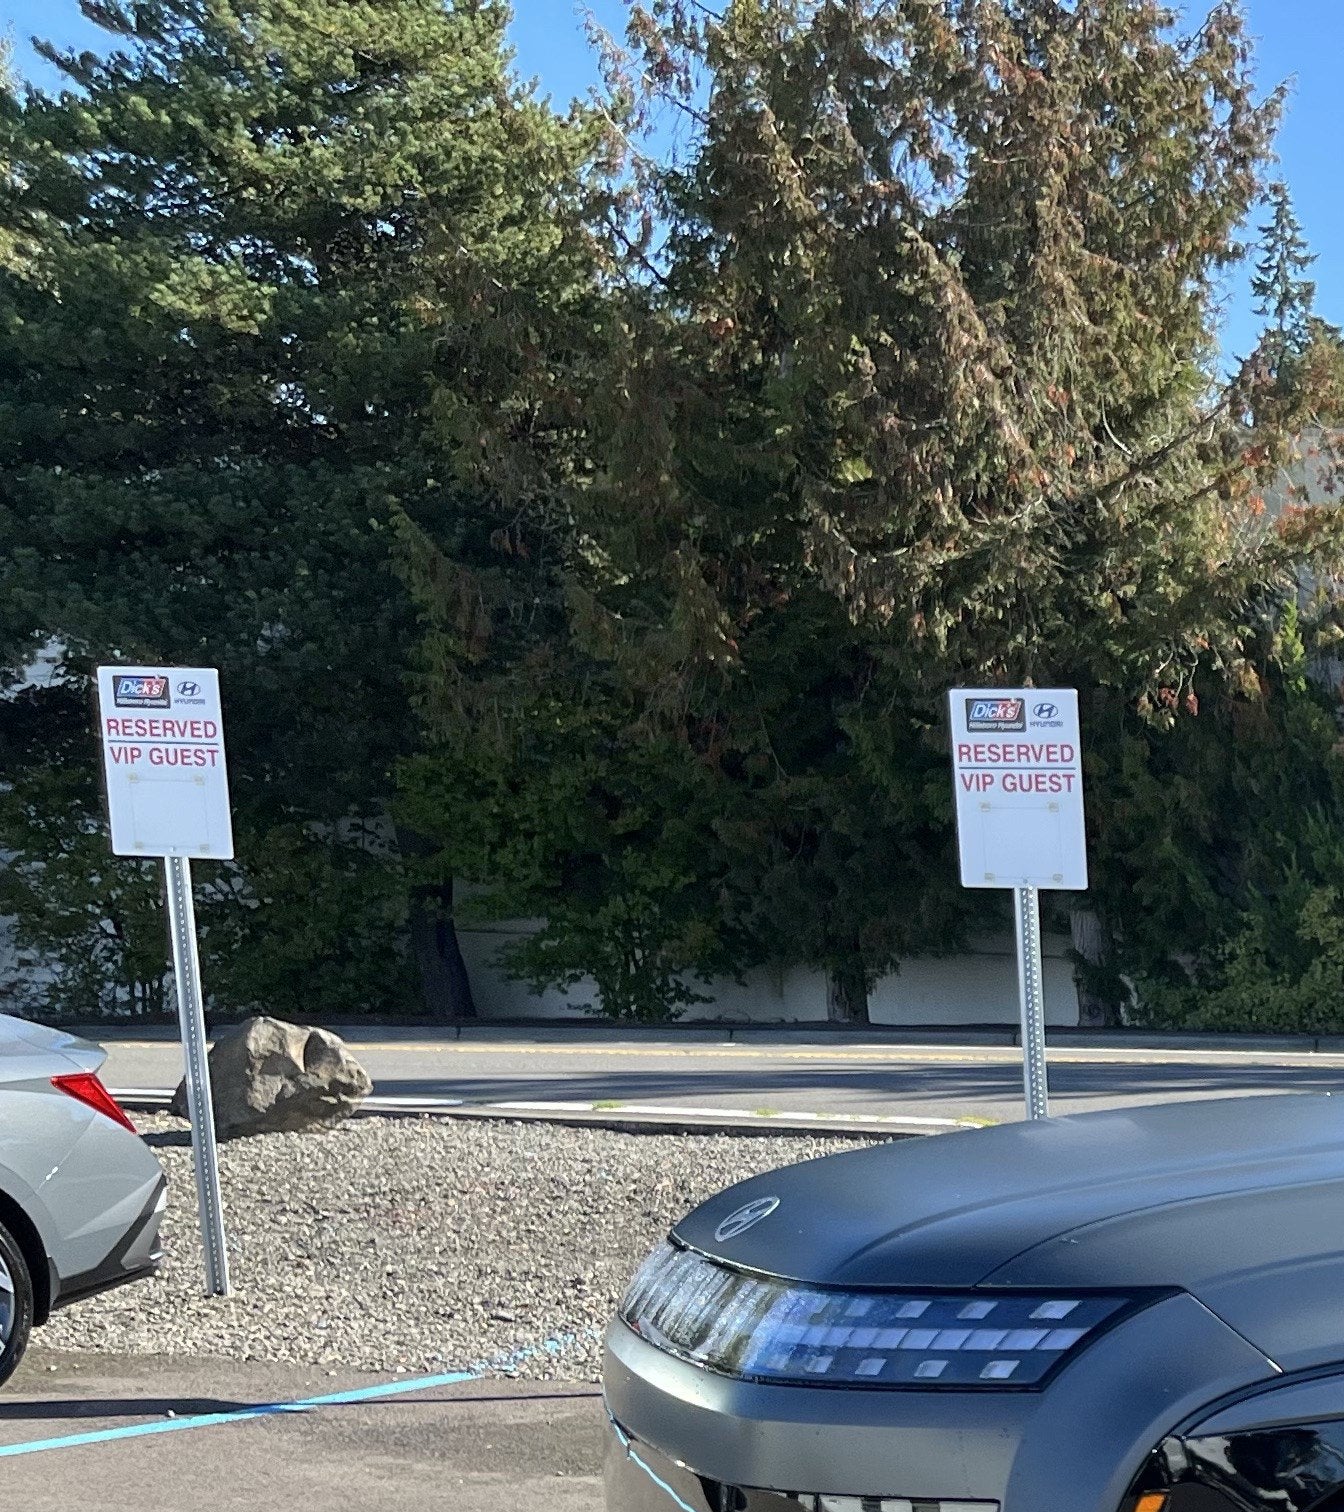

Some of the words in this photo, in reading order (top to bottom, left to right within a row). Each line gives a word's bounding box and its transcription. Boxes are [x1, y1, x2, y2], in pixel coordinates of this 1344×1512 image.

[973, 703, 1016, 718] Dick's
[106, 718, 217, 738] RESERVED
[110, 746, 142, 764] VIP
[149, 747, 219, 767] GUEST
[958, 744, 1075, 763] RESERVED
[961, 774, 995, 792] VIP
[1002, 774, 1076, 793] GUEST
